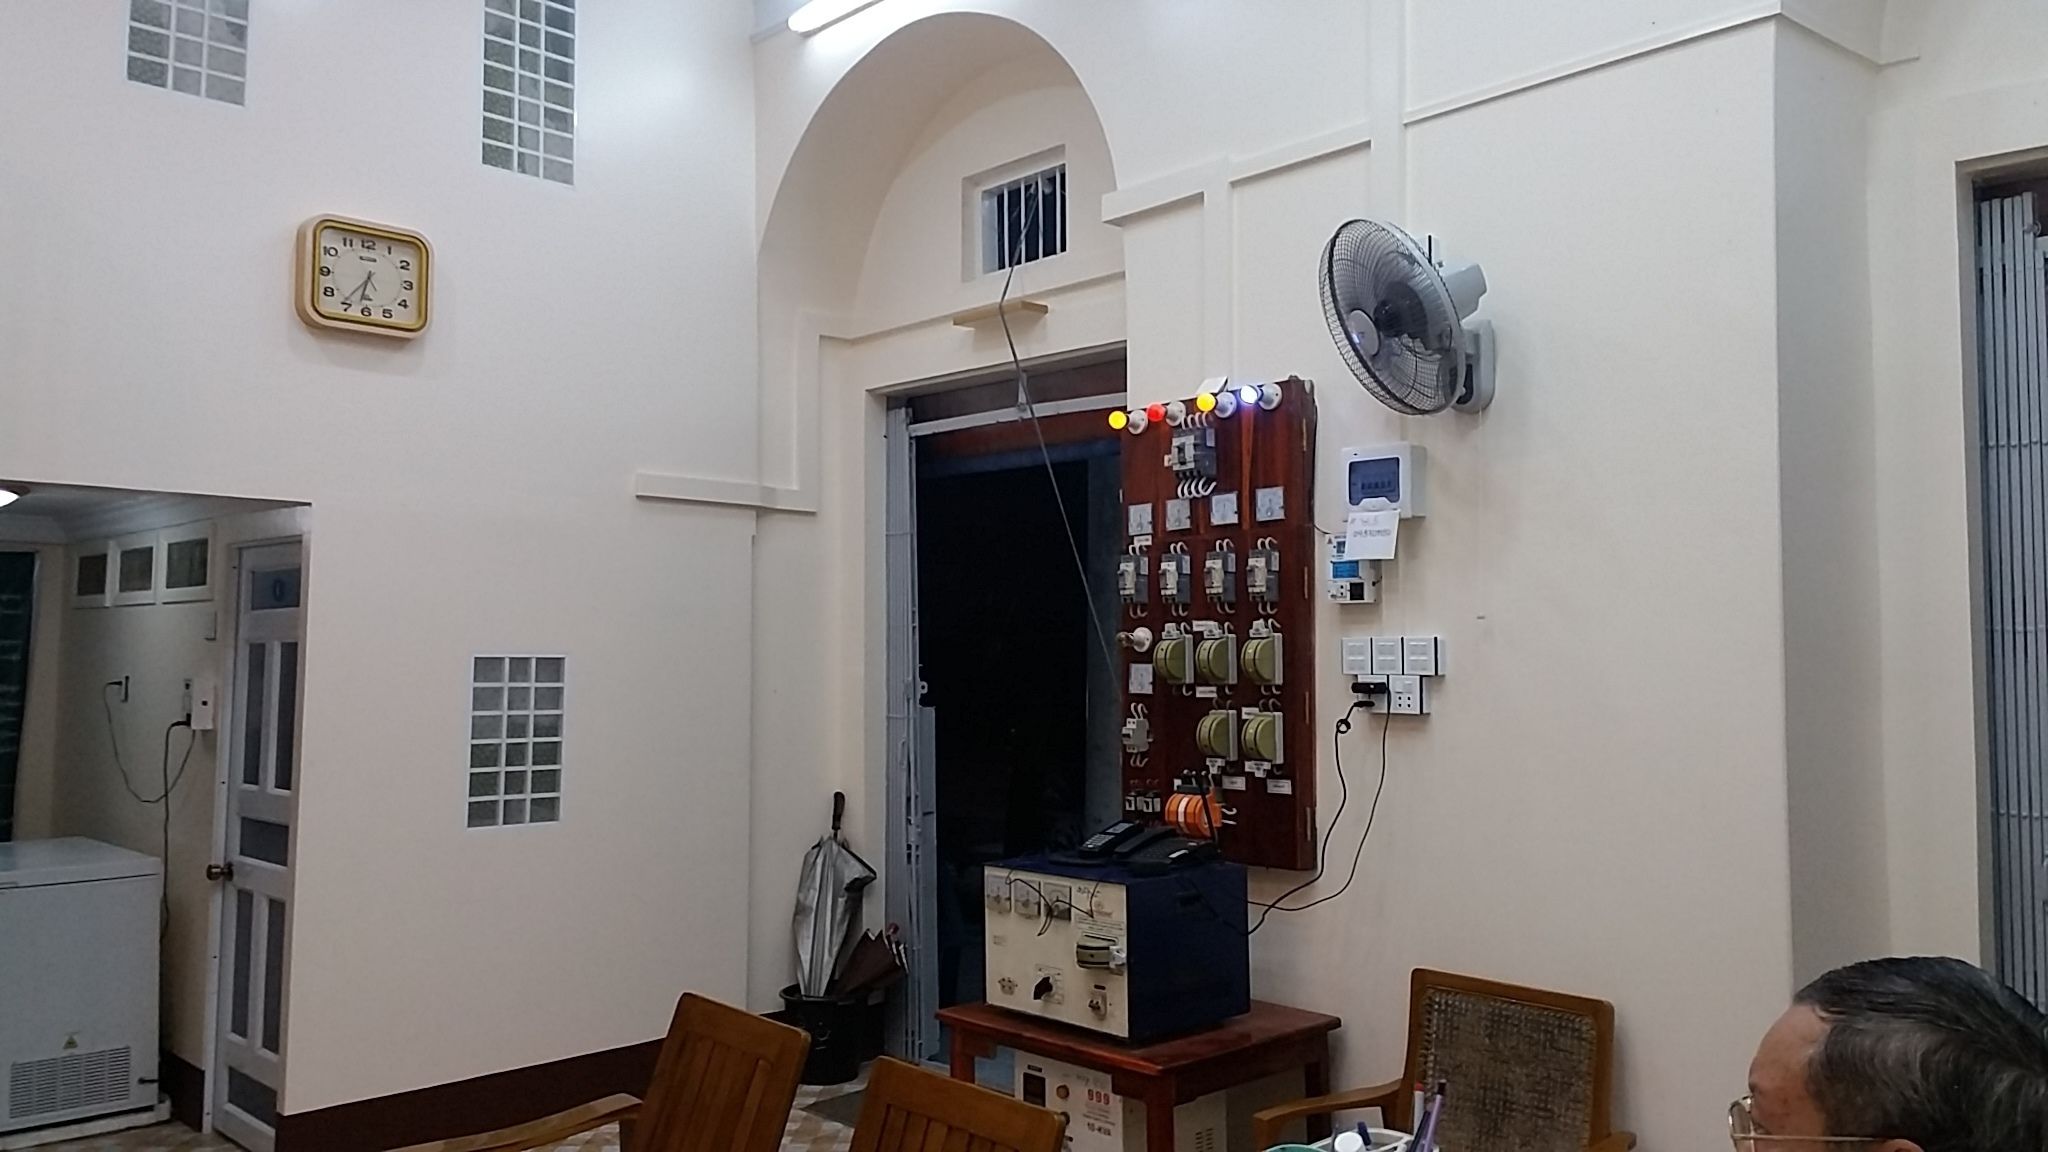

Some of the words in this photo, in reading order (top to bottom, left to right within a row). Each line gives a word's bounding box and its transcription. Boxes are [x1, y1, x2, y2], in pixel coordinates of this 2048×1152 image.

[342, 238, 354, 248] 11
[361, 239, 376, 250] 12
[323, 246, 338, 256] 10
[387, 246, 392, 255] 1
[399, 260, 411, 271] 2
[319, 266, 331, 276] 9
[403, 280, 414, 291] 3
[323, 286, 334, 297] 8
[341, 302, 352, 312] 7
[397, 299, 409, 309] 4
[360, 307, 372, 317] 6
[382, 308, 393, 319] 5
